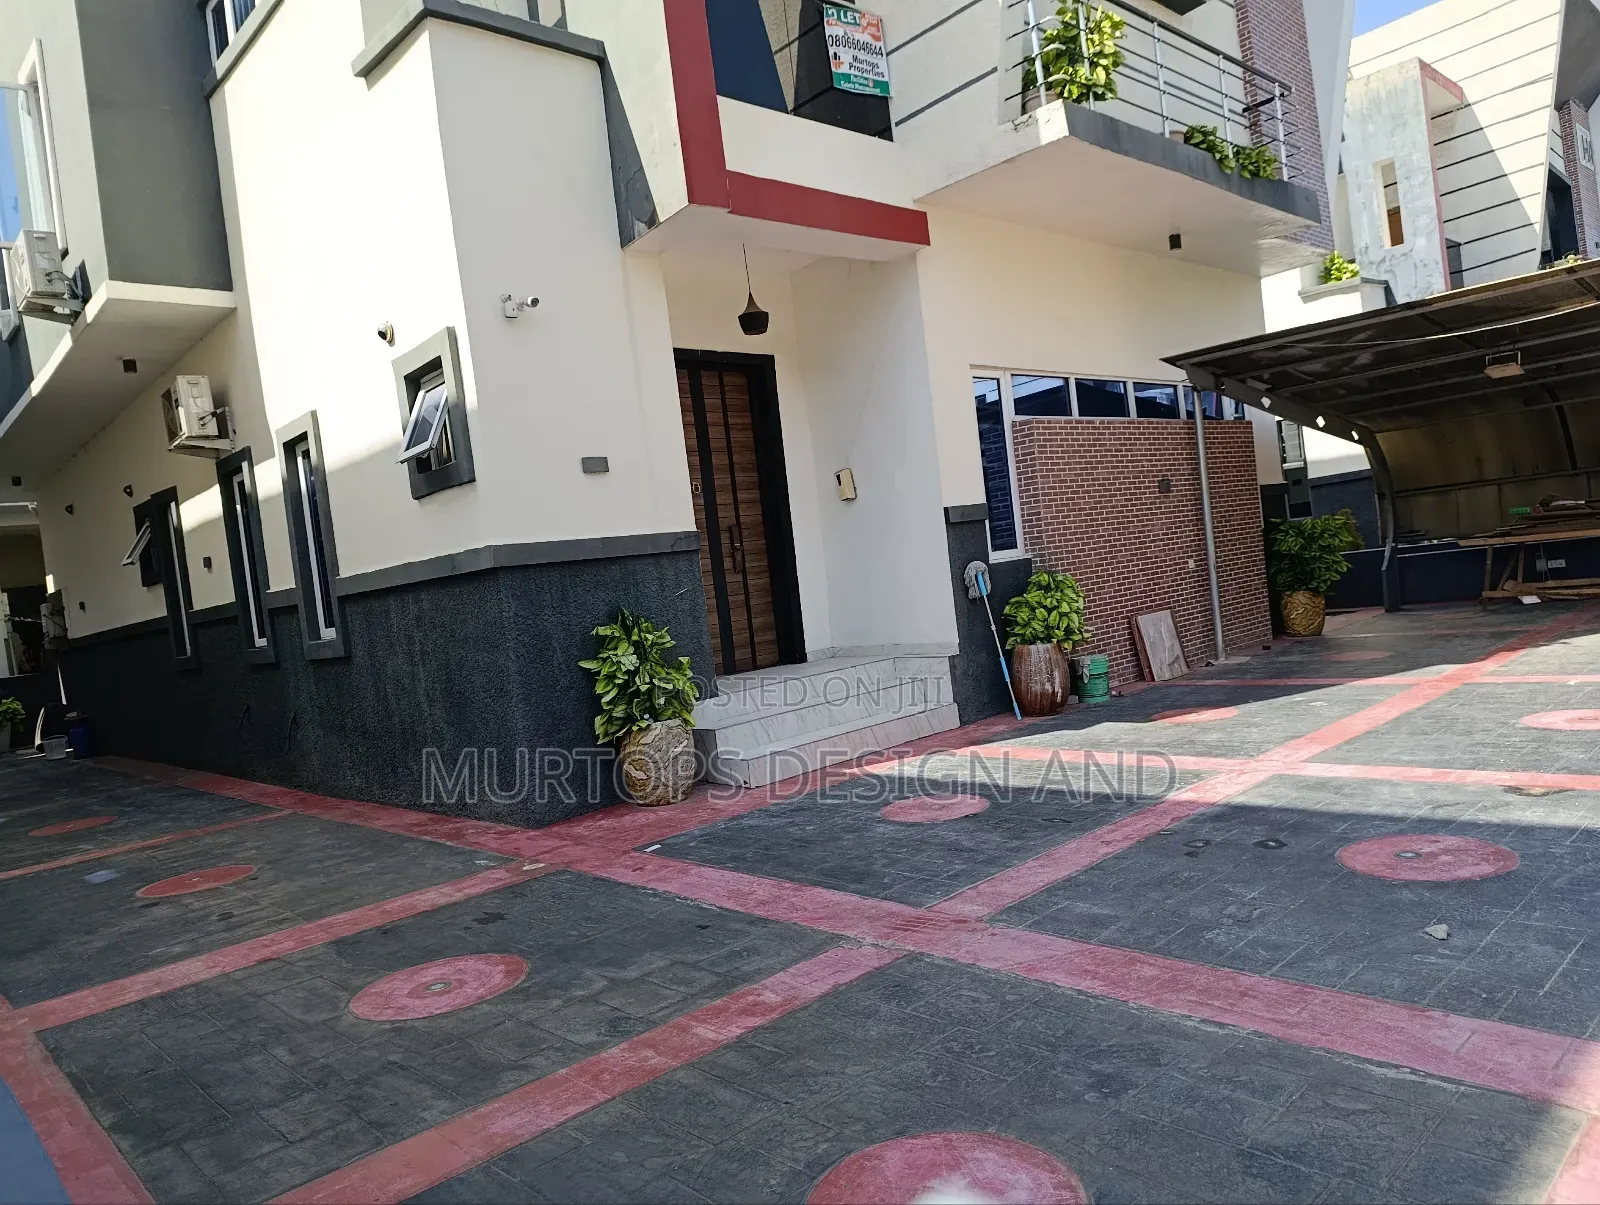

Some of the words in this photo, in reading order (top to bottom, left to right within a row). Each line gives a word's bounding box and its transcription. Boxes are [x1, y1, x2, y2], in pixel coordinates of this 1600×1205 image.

[840, 9, 861, 25] LET
[848, 62, 885, 78] Properties
[852, 54, 880, 70] Murtops
